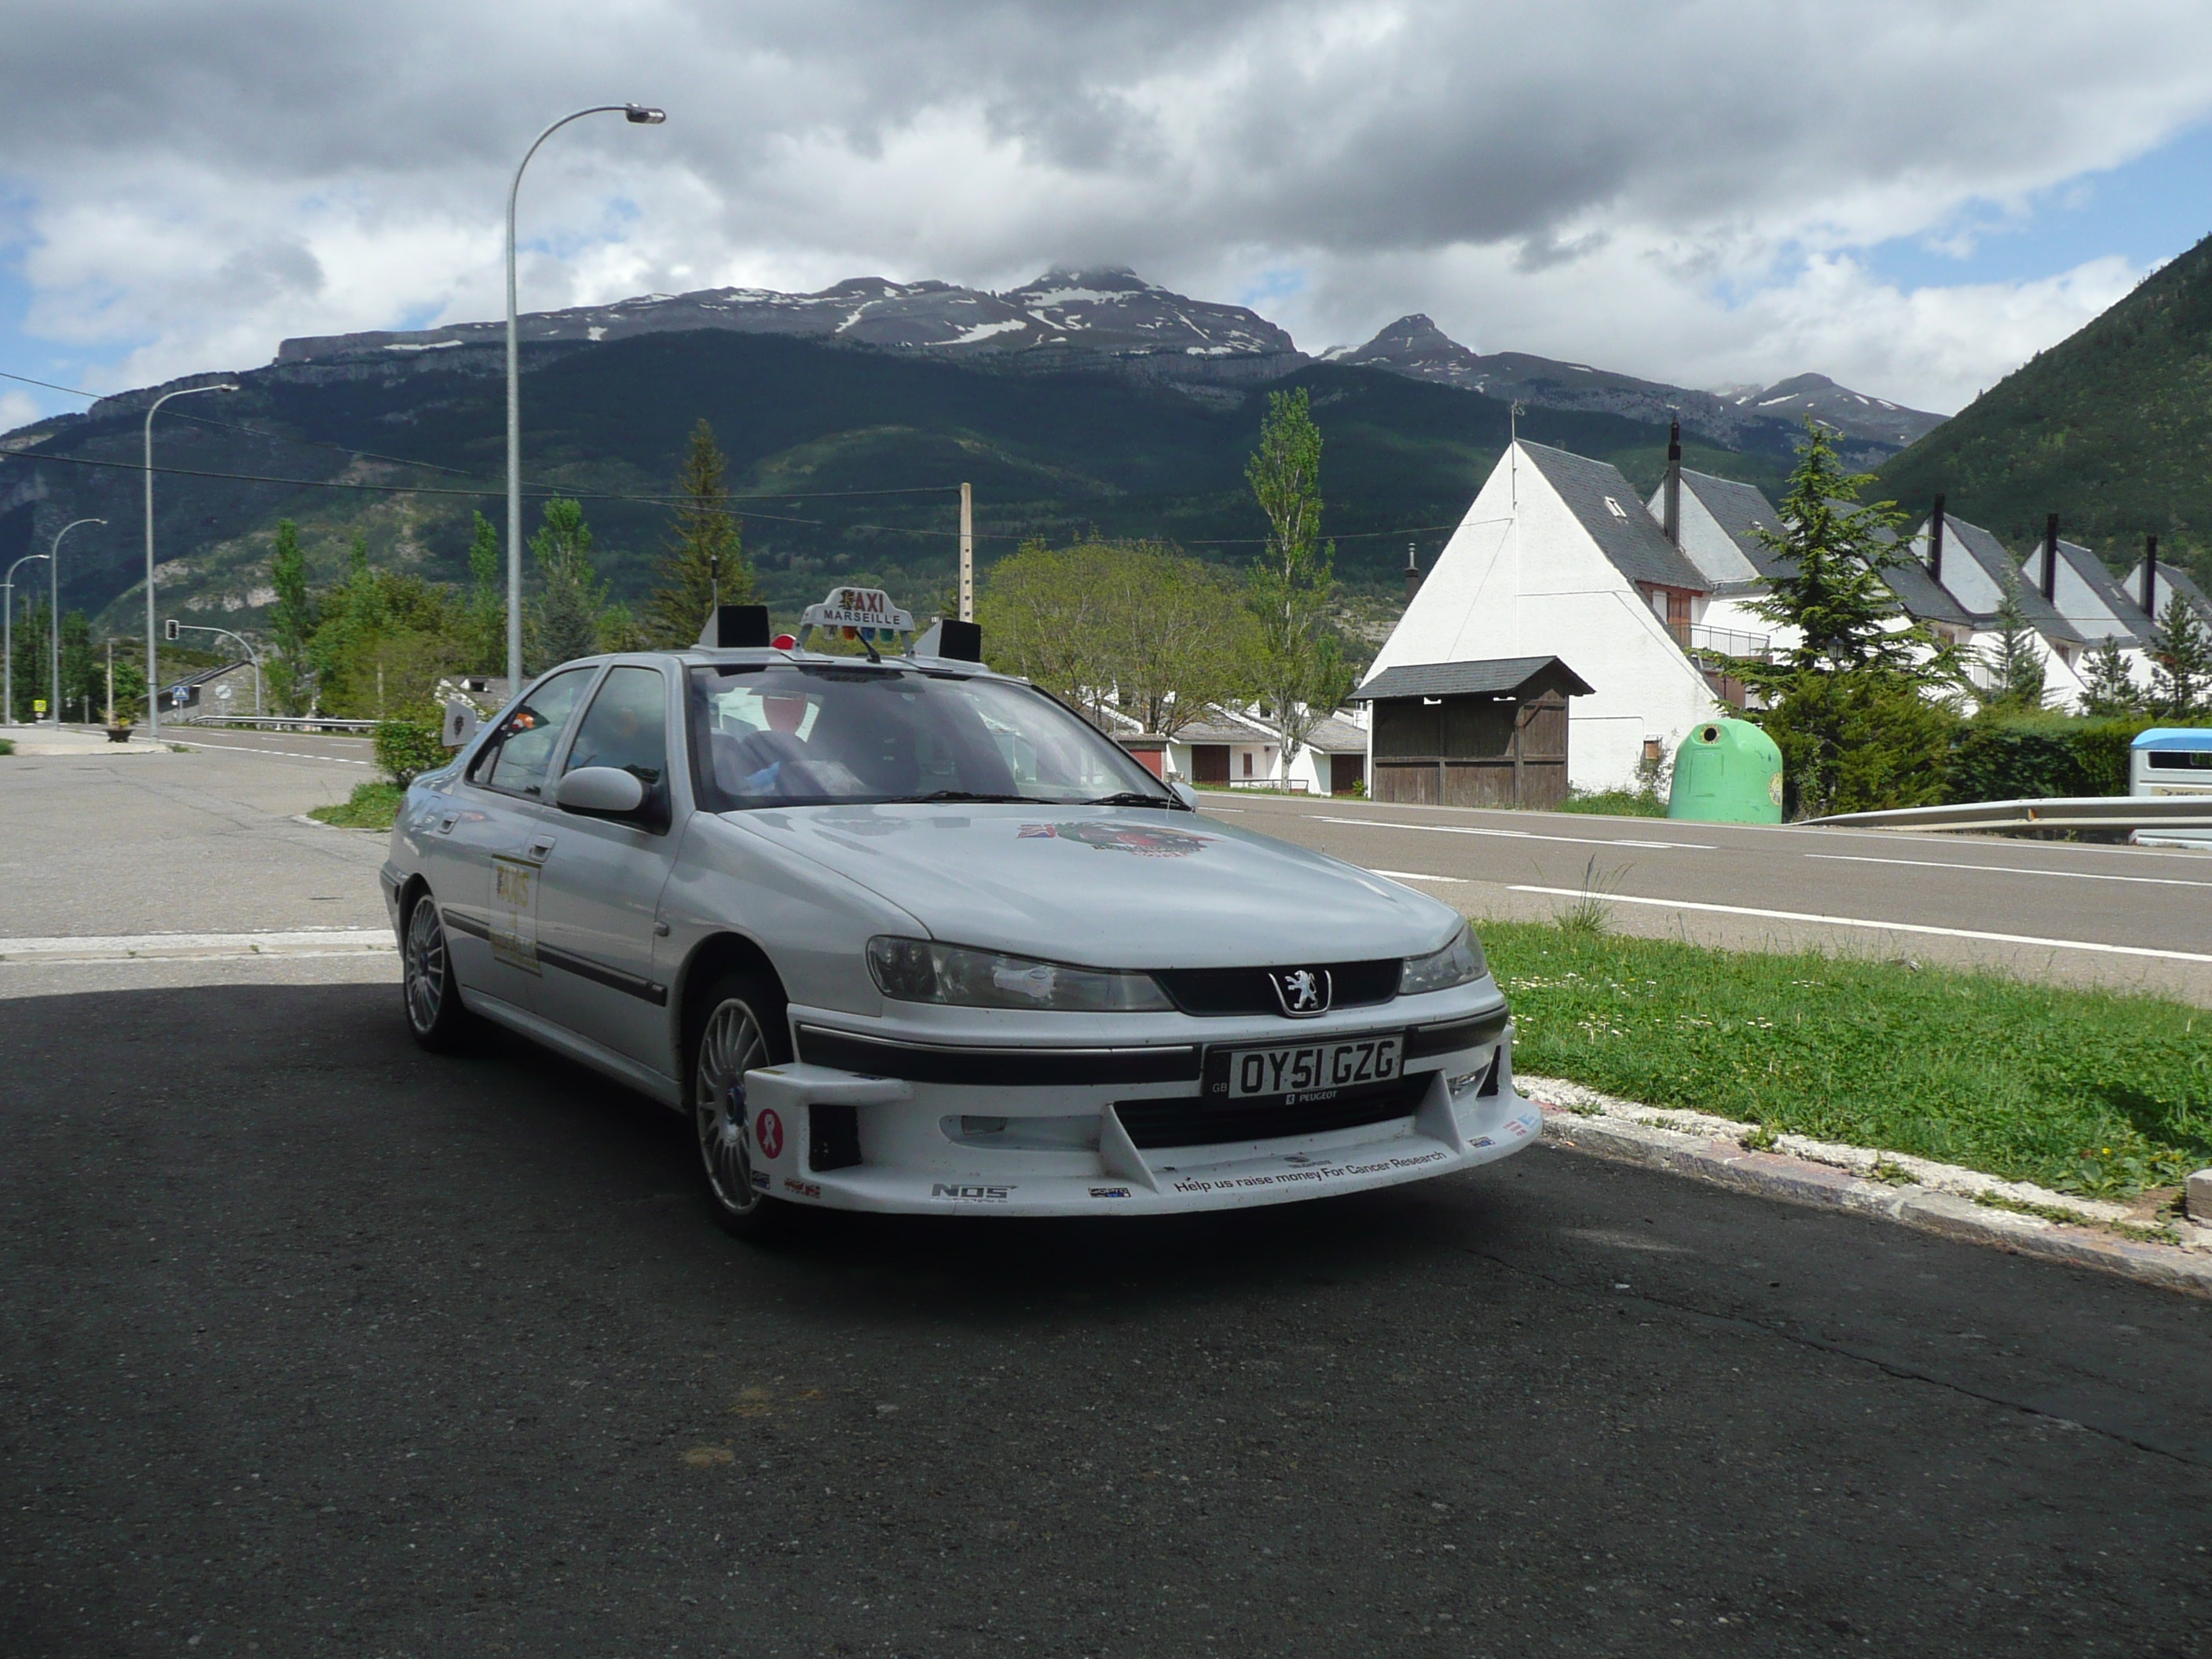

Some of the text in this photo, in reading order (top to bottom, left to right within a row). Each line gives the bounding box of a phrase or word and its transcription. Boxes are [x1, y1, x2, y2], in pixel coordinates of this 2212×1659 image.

[824, 610, 900, 624] MARSEILLE
[1240, 1041, 1394, 1093] OY51 GZG
[1213, 1082, 1228, 1093] GB
[1299, 1090, 1338, 1103] PEUGEOT
[1174, 1180, 1211, 1192] Help
[1214, 1180, 1233, 1188] us
[1236, 1176, 1273, 1187] raise
[1276, 1170, 1322, 1183] money
[1320, 1167, 1344, 1177] For
[1346, 1163, 1391, 1174] Cancer
[1390, 1151, 1447, 1168] Research
[932, 1184, 1009, 1199] NOS
